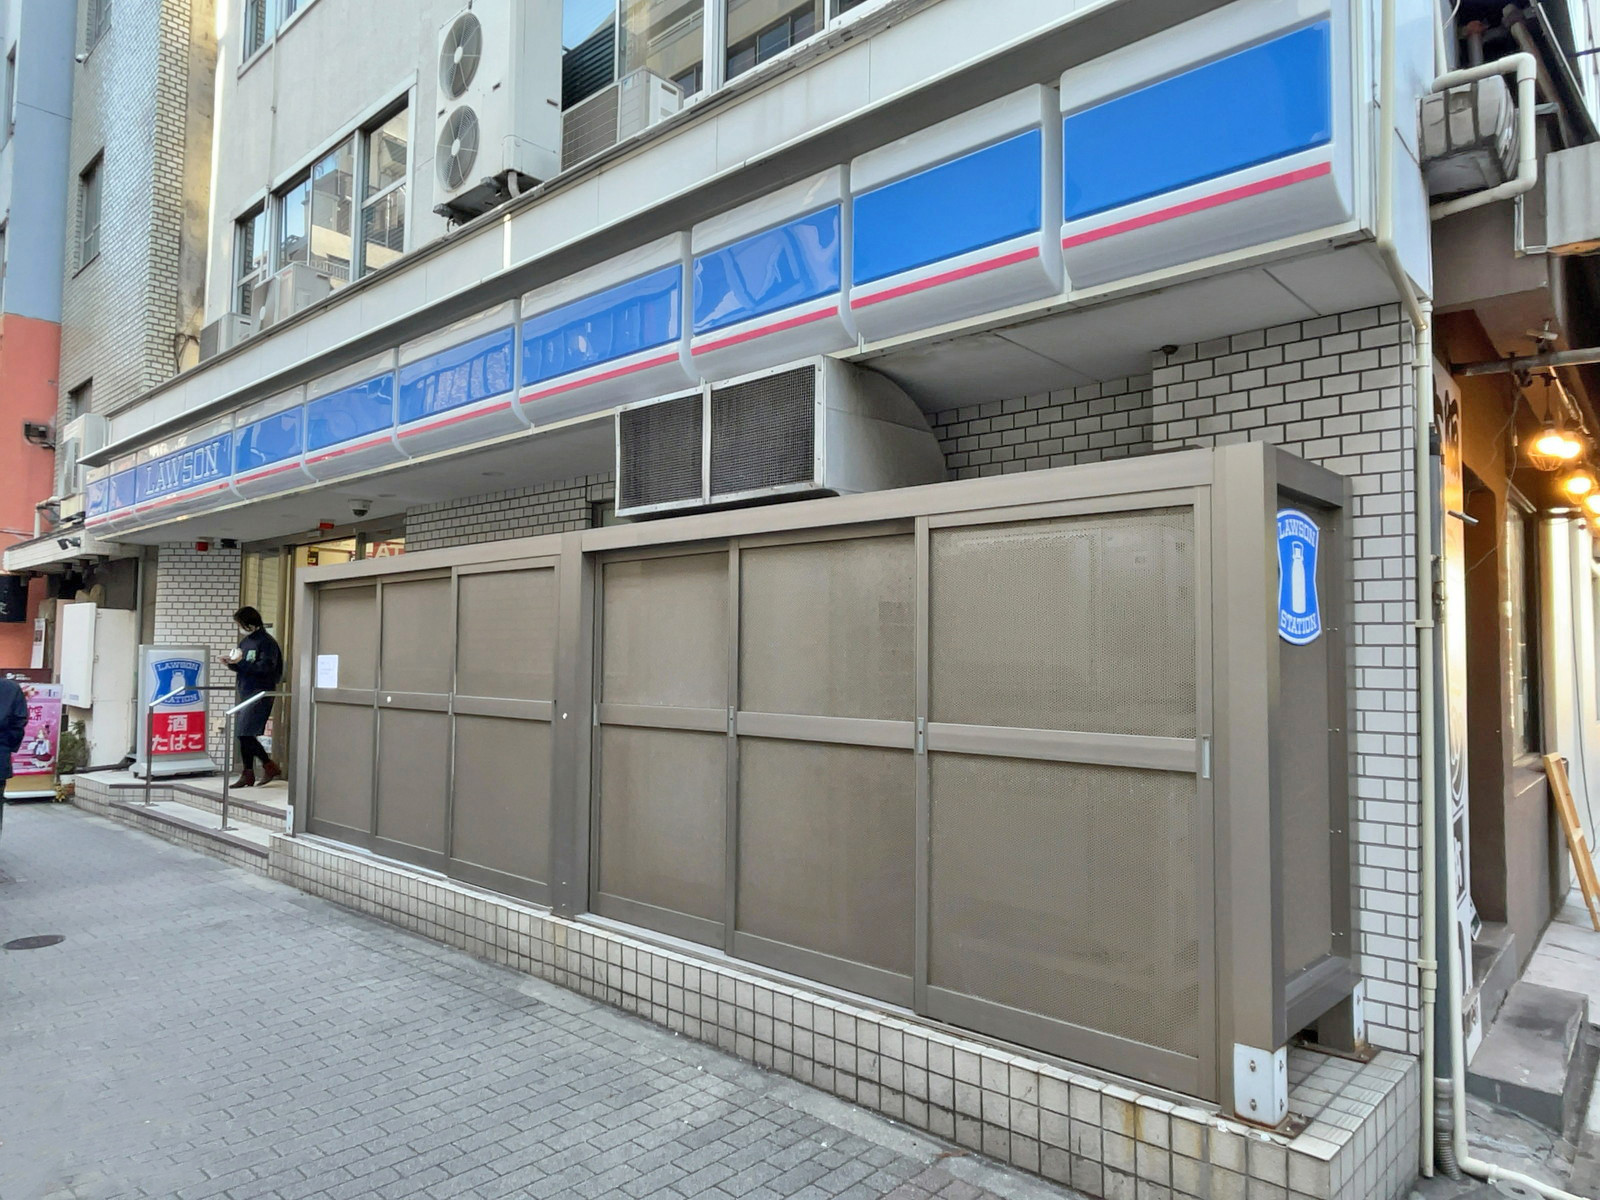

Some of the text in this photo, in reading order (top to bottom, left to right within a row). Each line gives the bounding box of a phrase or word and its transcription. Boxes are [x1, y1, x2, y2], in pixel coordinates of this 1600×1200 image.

[146, 442, 220, 495] LAWSON
[1278, 519, 1316, 548] LAWSON
[1281, 609, 1318, 635] STATION
[157, 662, 199, 671] LAWSON
[167, 715, 188, 732] 酒
[152, 734, 202, 751] たばこ
